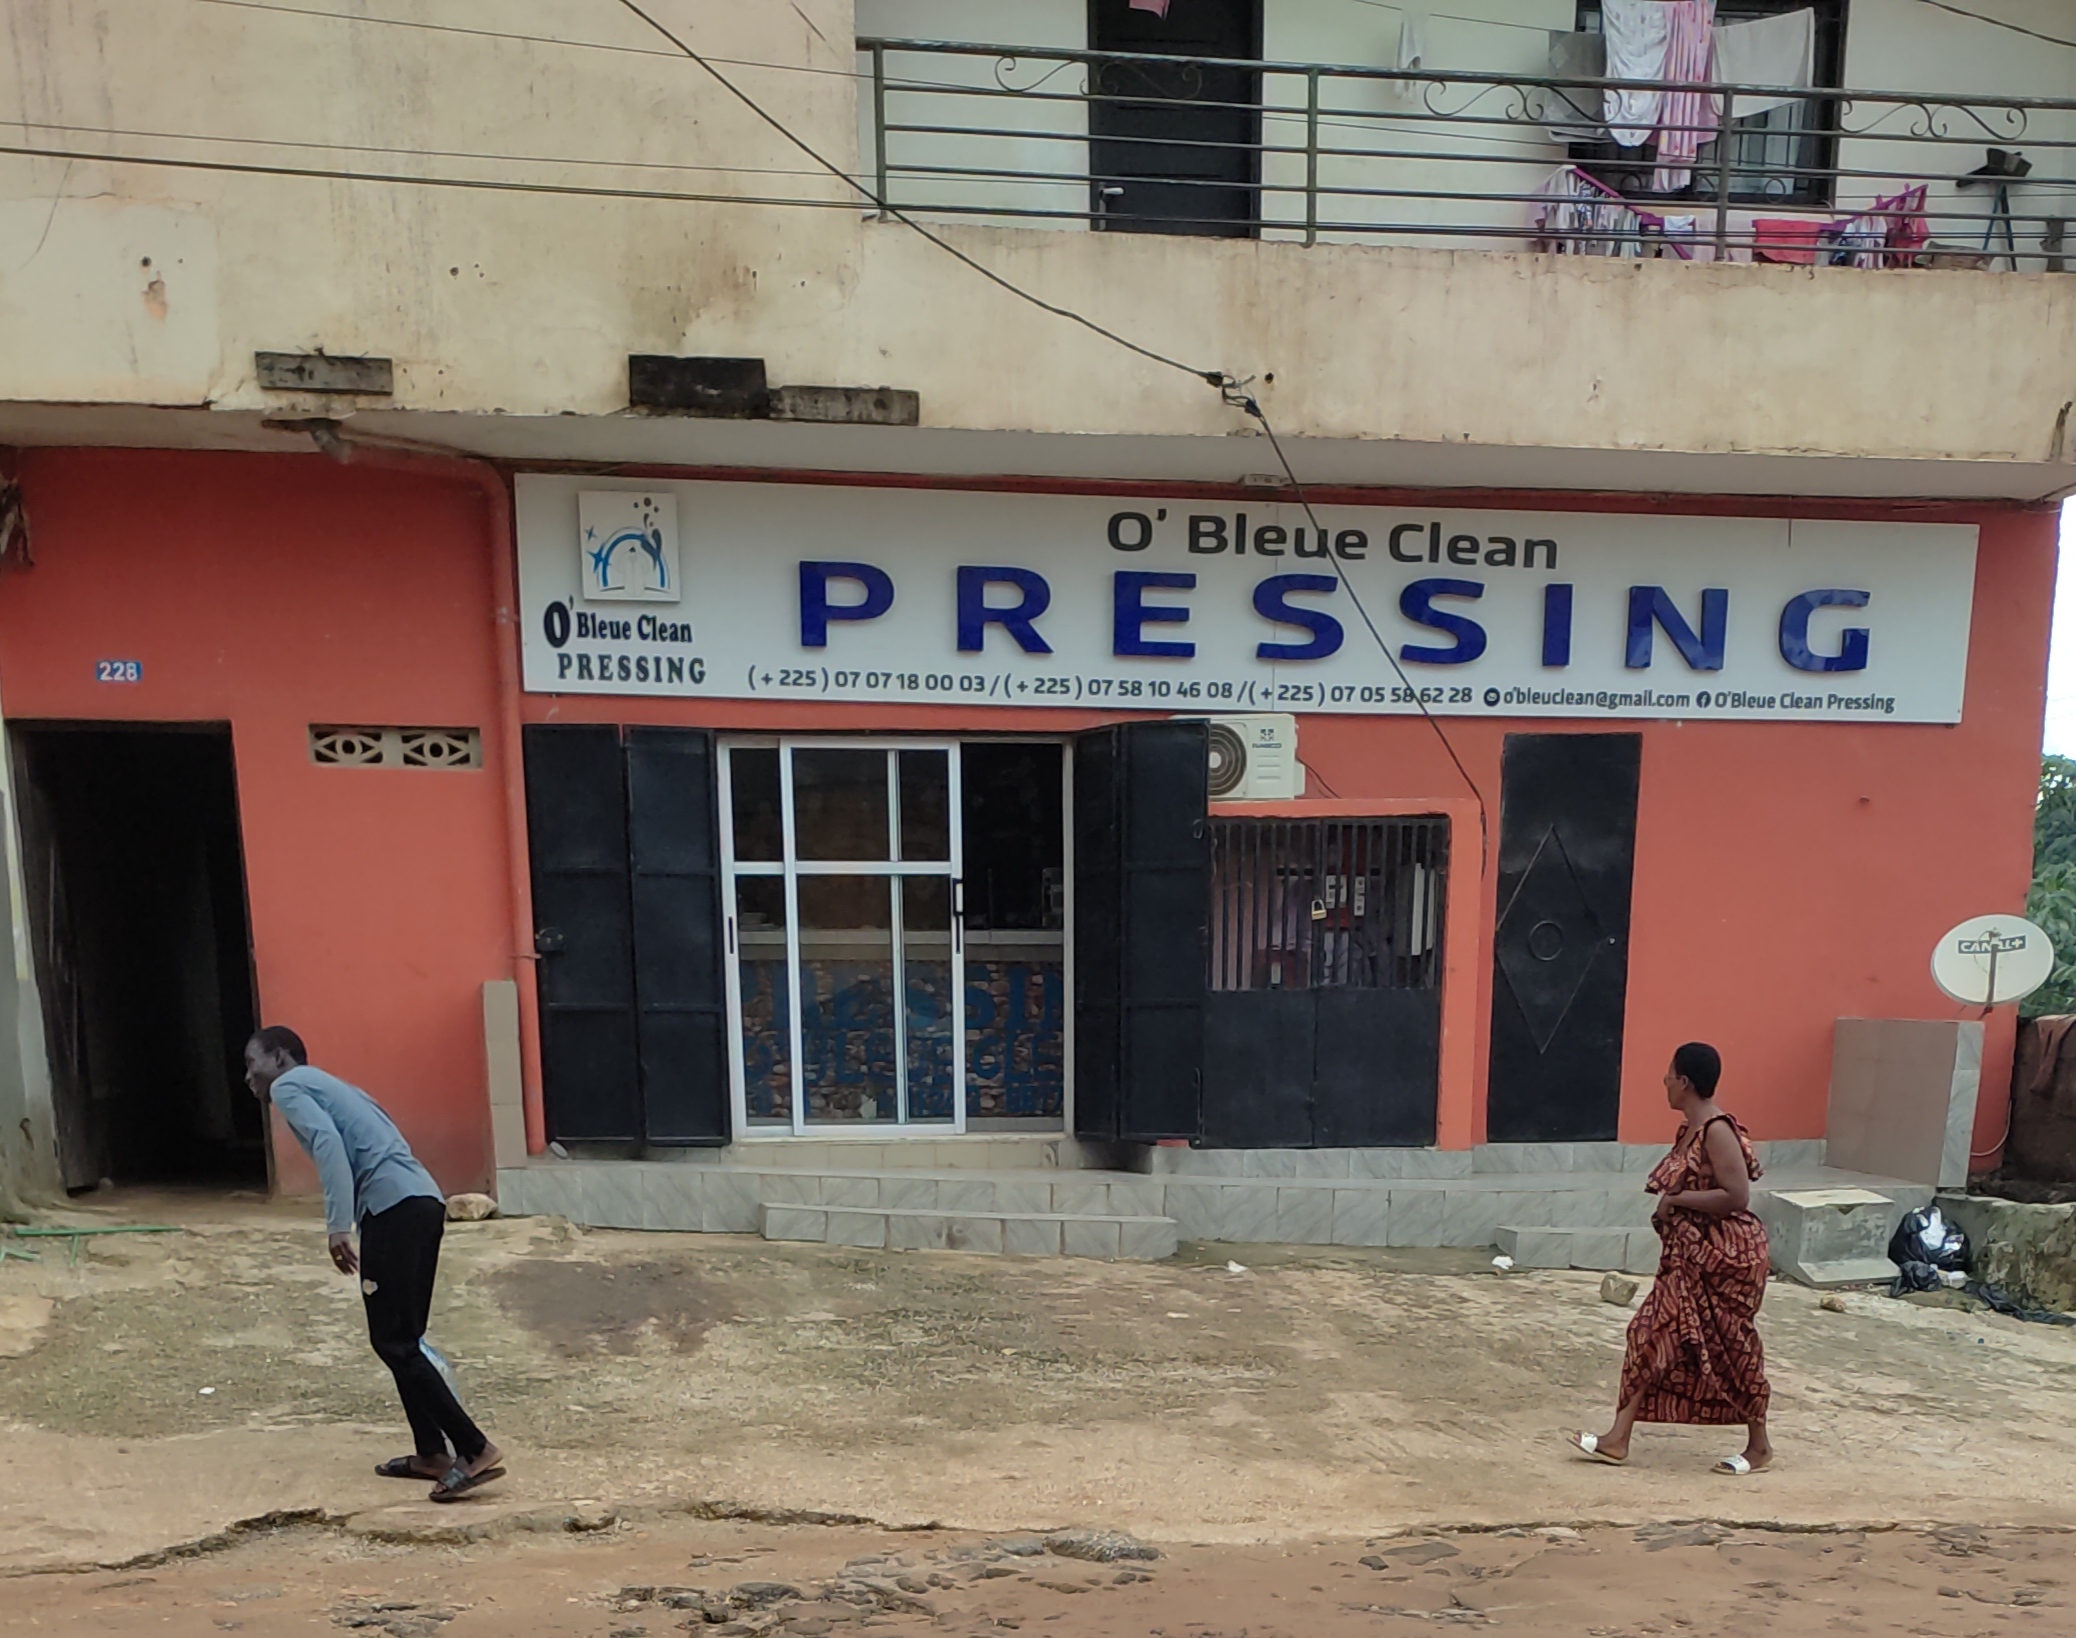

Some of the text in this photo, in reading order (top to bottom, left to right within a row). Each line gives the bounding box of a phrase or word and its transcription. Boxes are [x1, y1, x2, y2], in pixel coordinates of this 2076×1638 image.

[1188, 513, 1369, 560] Bleue
[1388, 521, 1559, 570] Clean
[637, 614, 693, 643] Clean
[799, 560, 1871, 673] PRESSING
[99, 661, 138, 681] 228
[557, 653, 706, 685] PRESSING
[1503, 687, 1690, 710] o'bleuclean@gmail.com
[1715, 691, 1776, 709] O'Bleue
[1780, 692, 1823, 709] Clean
[1827, 693, 1896, 714] Pressing
